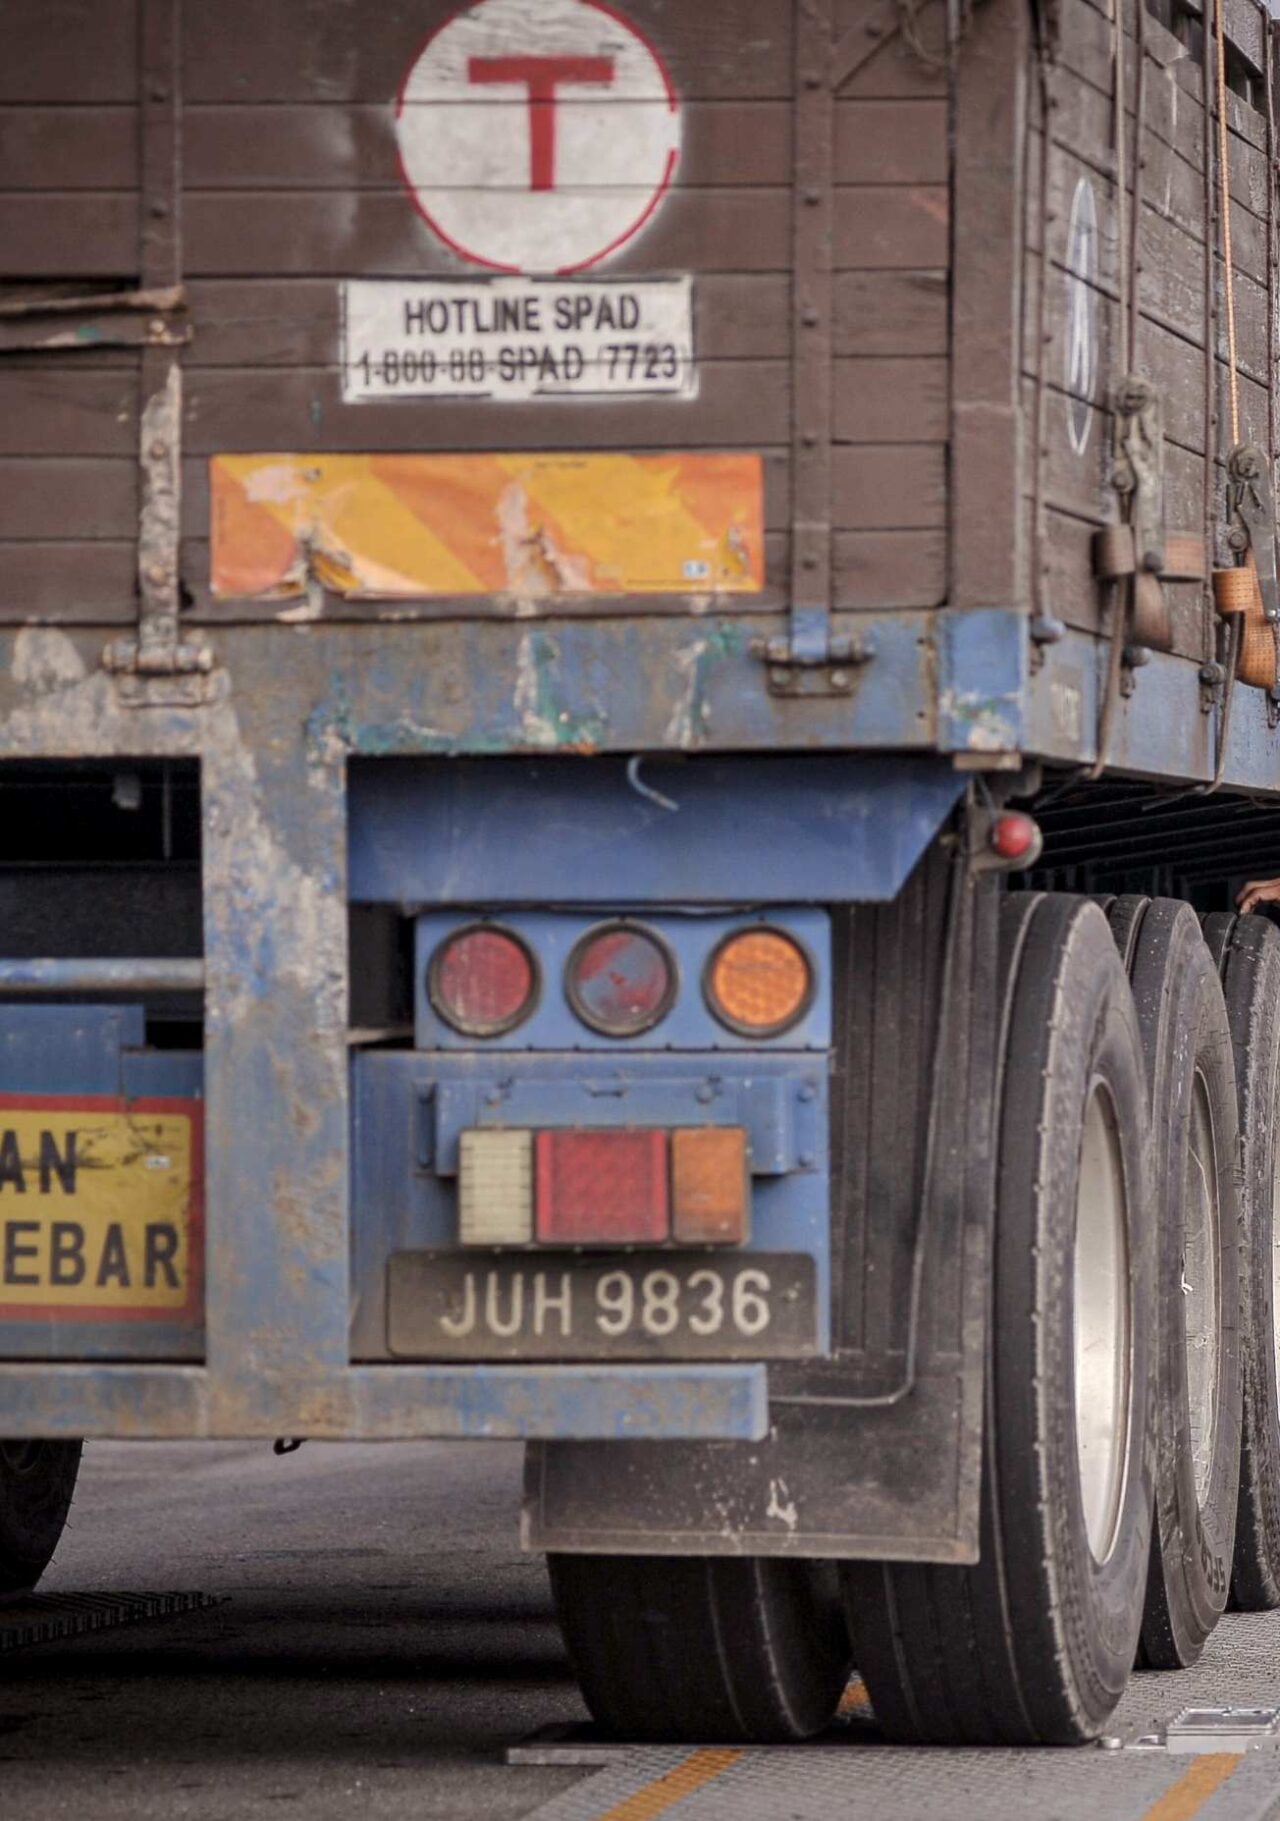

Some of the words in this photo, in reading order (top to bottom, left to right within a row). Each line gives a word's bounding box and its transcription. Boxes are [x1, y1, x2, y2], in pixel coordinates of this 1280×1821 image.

[468, 56, 615, 191] T
[404, 298, 540, 335] HOTLINE
[555, 294, 639, 331] SPAD
[4, 1221, 180, 1288] EBAR
[440, 1272, 571, 1338] JUH
[595, 1269, 771, 1337] 9836
